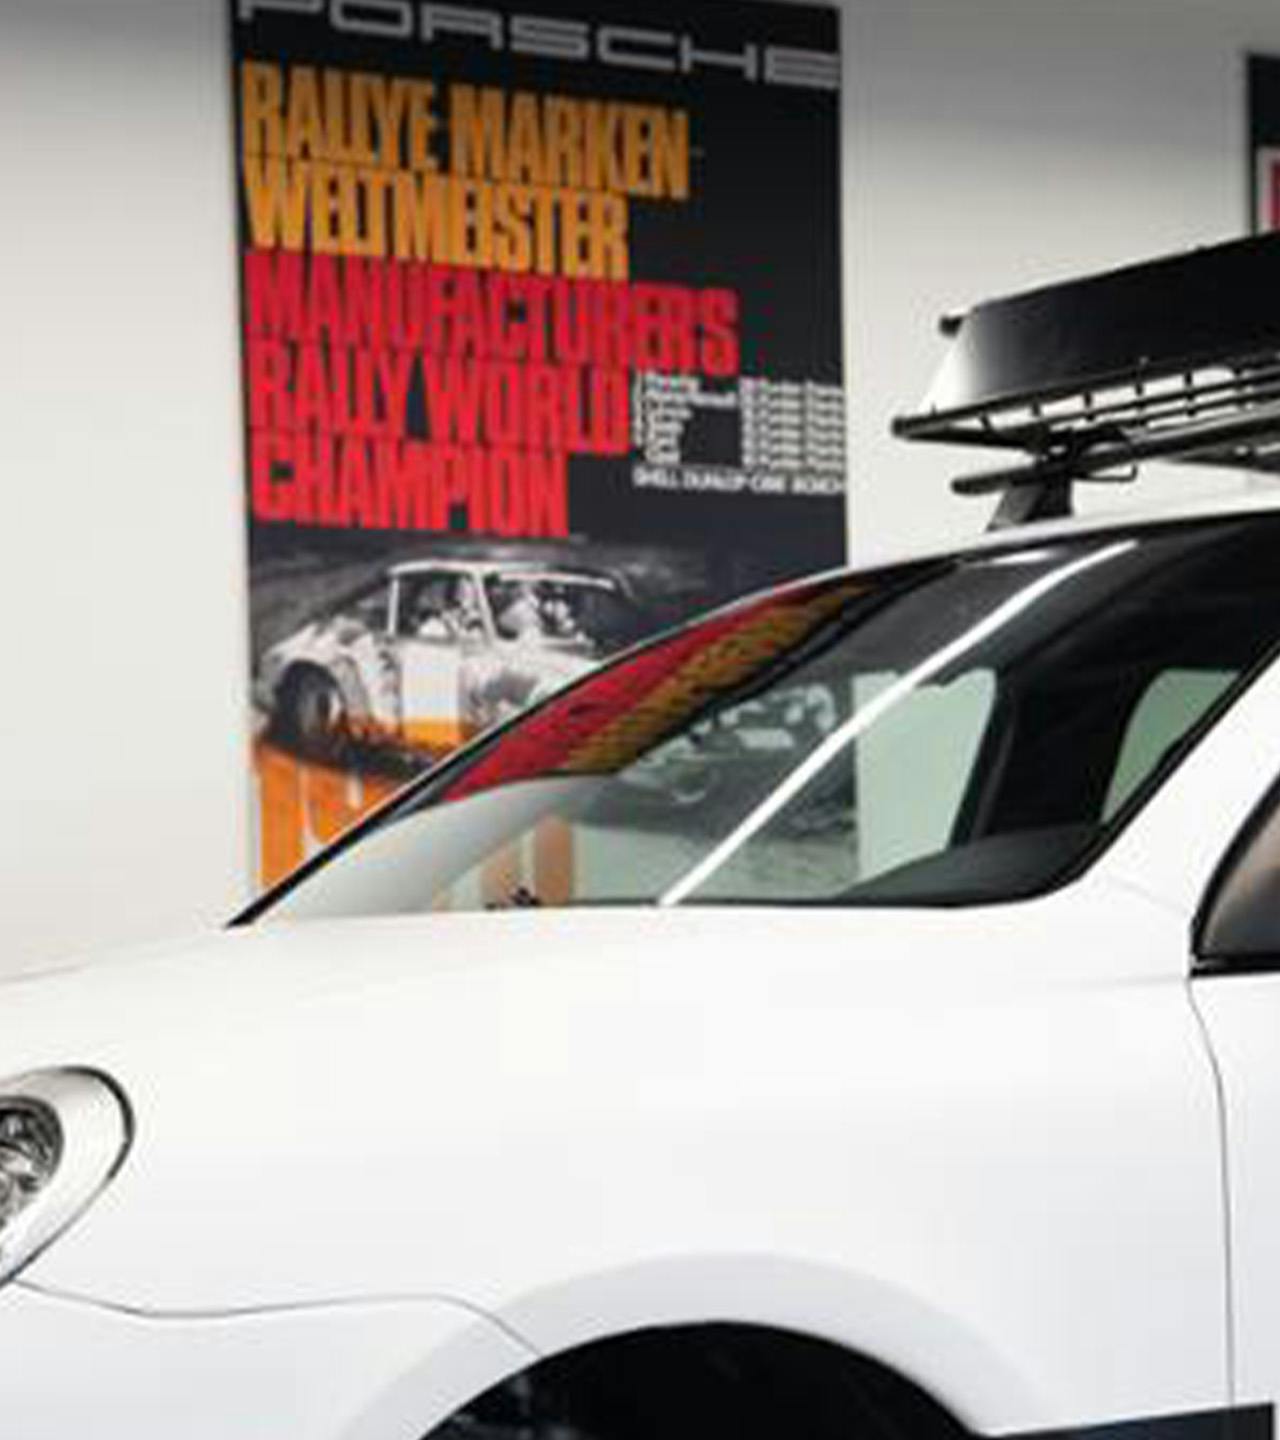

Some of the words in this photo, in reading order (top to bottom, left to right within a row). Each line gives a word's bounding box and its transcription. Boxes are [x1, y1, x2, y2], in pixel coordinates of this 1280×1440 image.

[449, 83, 690, 200] MARKEN
[242, 154, 629, 281] WELTMEISTER
[244, 253, 739, 376] MANUFACTURERS
[246, 332, 410, 440] RALLY
[420, 354, 630, 456] WORLD
[248, 432, 571, 539] CHAMPION
